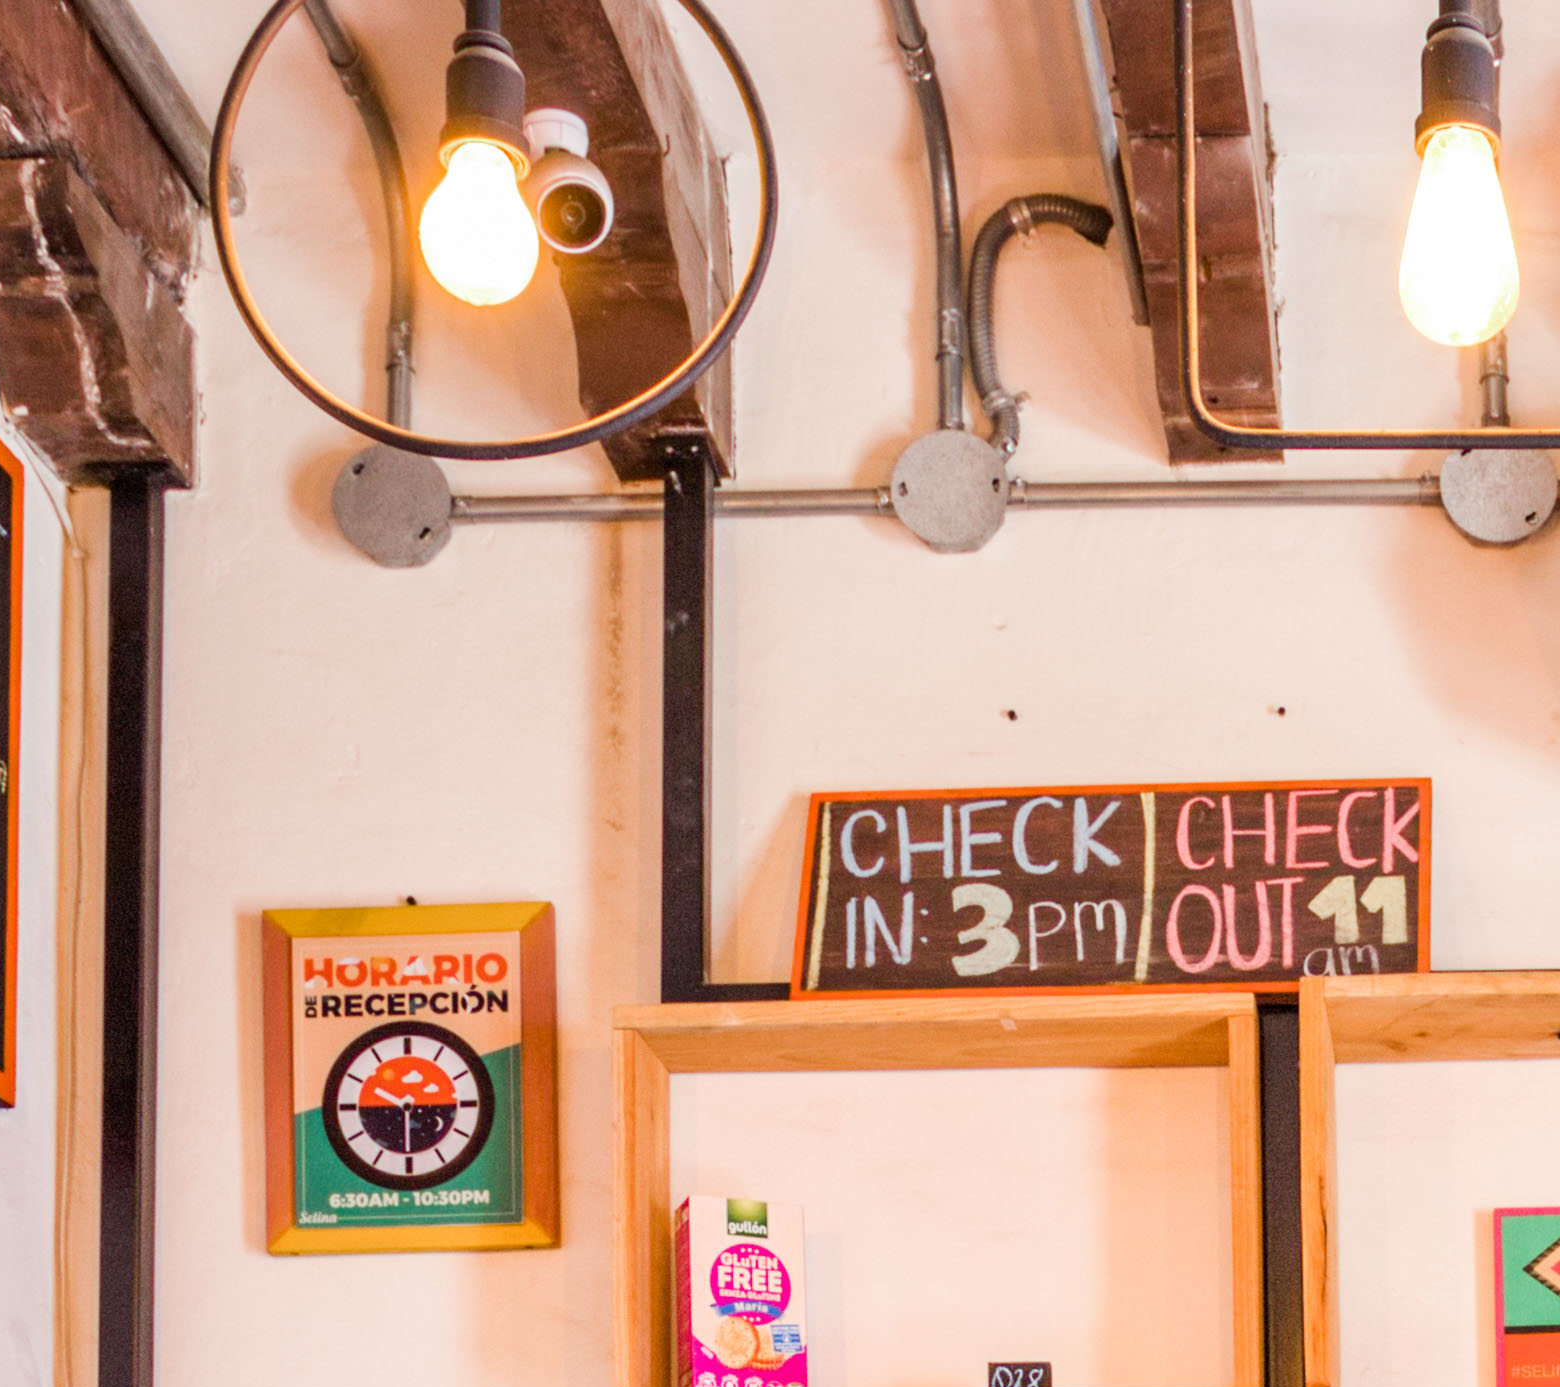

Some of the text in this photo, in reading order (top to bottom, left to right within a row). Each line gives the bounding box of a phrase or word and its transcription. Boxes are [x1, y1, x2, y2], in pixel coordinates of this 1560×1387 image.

[840, 787, 1421, 884] CHECK CHECK
[846, 891, 930, 969] IN:
[1166, 876, 1305, 975] OUT
[1307, 874, 1409, 945] 11
[303, 952, 509, 991] HORARIO
[304, 984, 510, 1018] DE RECEPCIÓN
[329, 1190, 400, 1209] 6:30AM
[413, 1188, 491, 1206] 10:30PM
[298, 1210, 339, 1225] Selina
[716, 1265, 783, 1294] FREE
